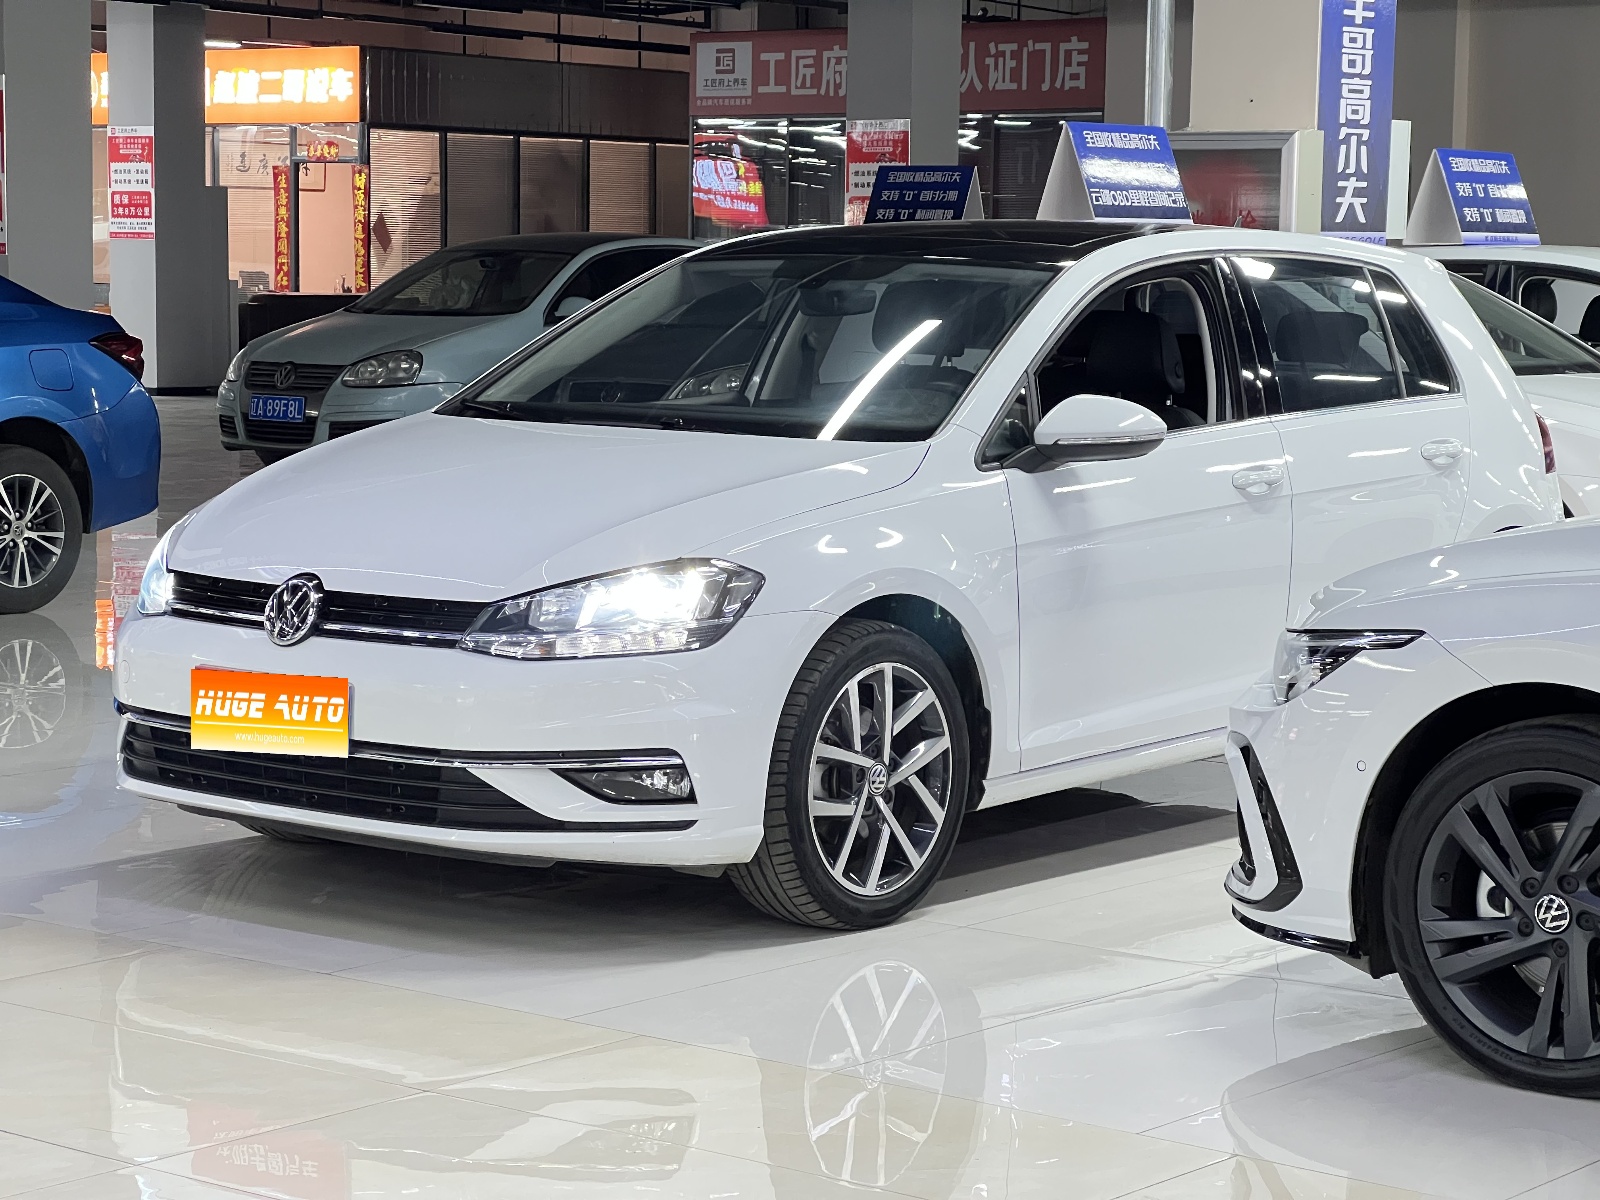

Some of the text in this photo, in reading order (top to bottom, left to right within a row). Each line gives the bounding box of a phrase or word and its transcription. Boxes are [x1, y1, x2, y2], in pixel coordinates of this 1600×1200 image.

[757, 36, 1089, 97] 工匠府 认证门店
[703, 78, 748, 88] 工匠府上养车
[1083, 131, 1160, 151] 全国收精品高尔夫
[1448, 157, 1511, 175] 全国收精品高尔夫
[886, 171, 962, 183] 全国收精品高尔夫
[113, 194, 130, 205] 质保
[113, 206, 151, 217] 3年8万公里
